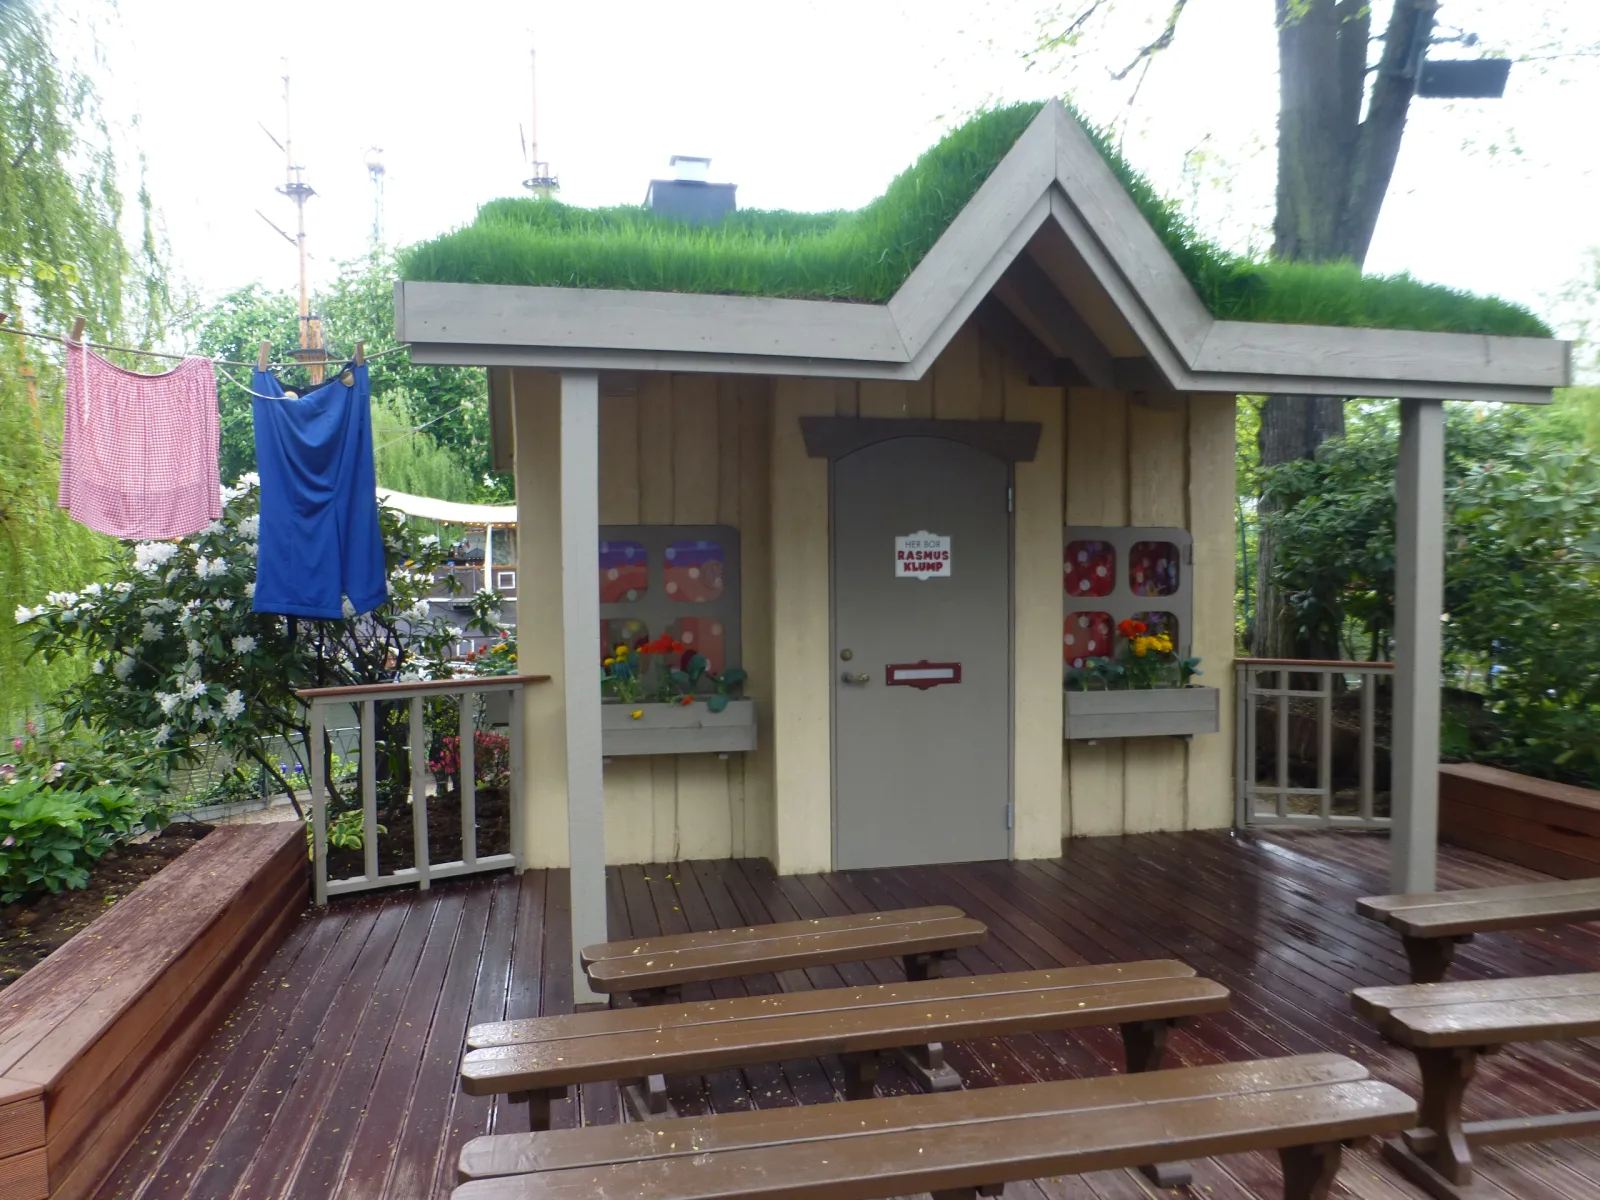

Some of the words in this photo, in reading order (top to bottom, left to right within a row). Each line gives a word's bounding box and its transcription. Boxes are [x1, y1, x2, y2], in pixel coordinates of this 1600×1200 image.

[905, 540, 921, 549] HER
[923, 540, 941, 549] BOR
[897, 550, 949, 561] RASMUS
[903, 561, 944, 572] KLUMP
